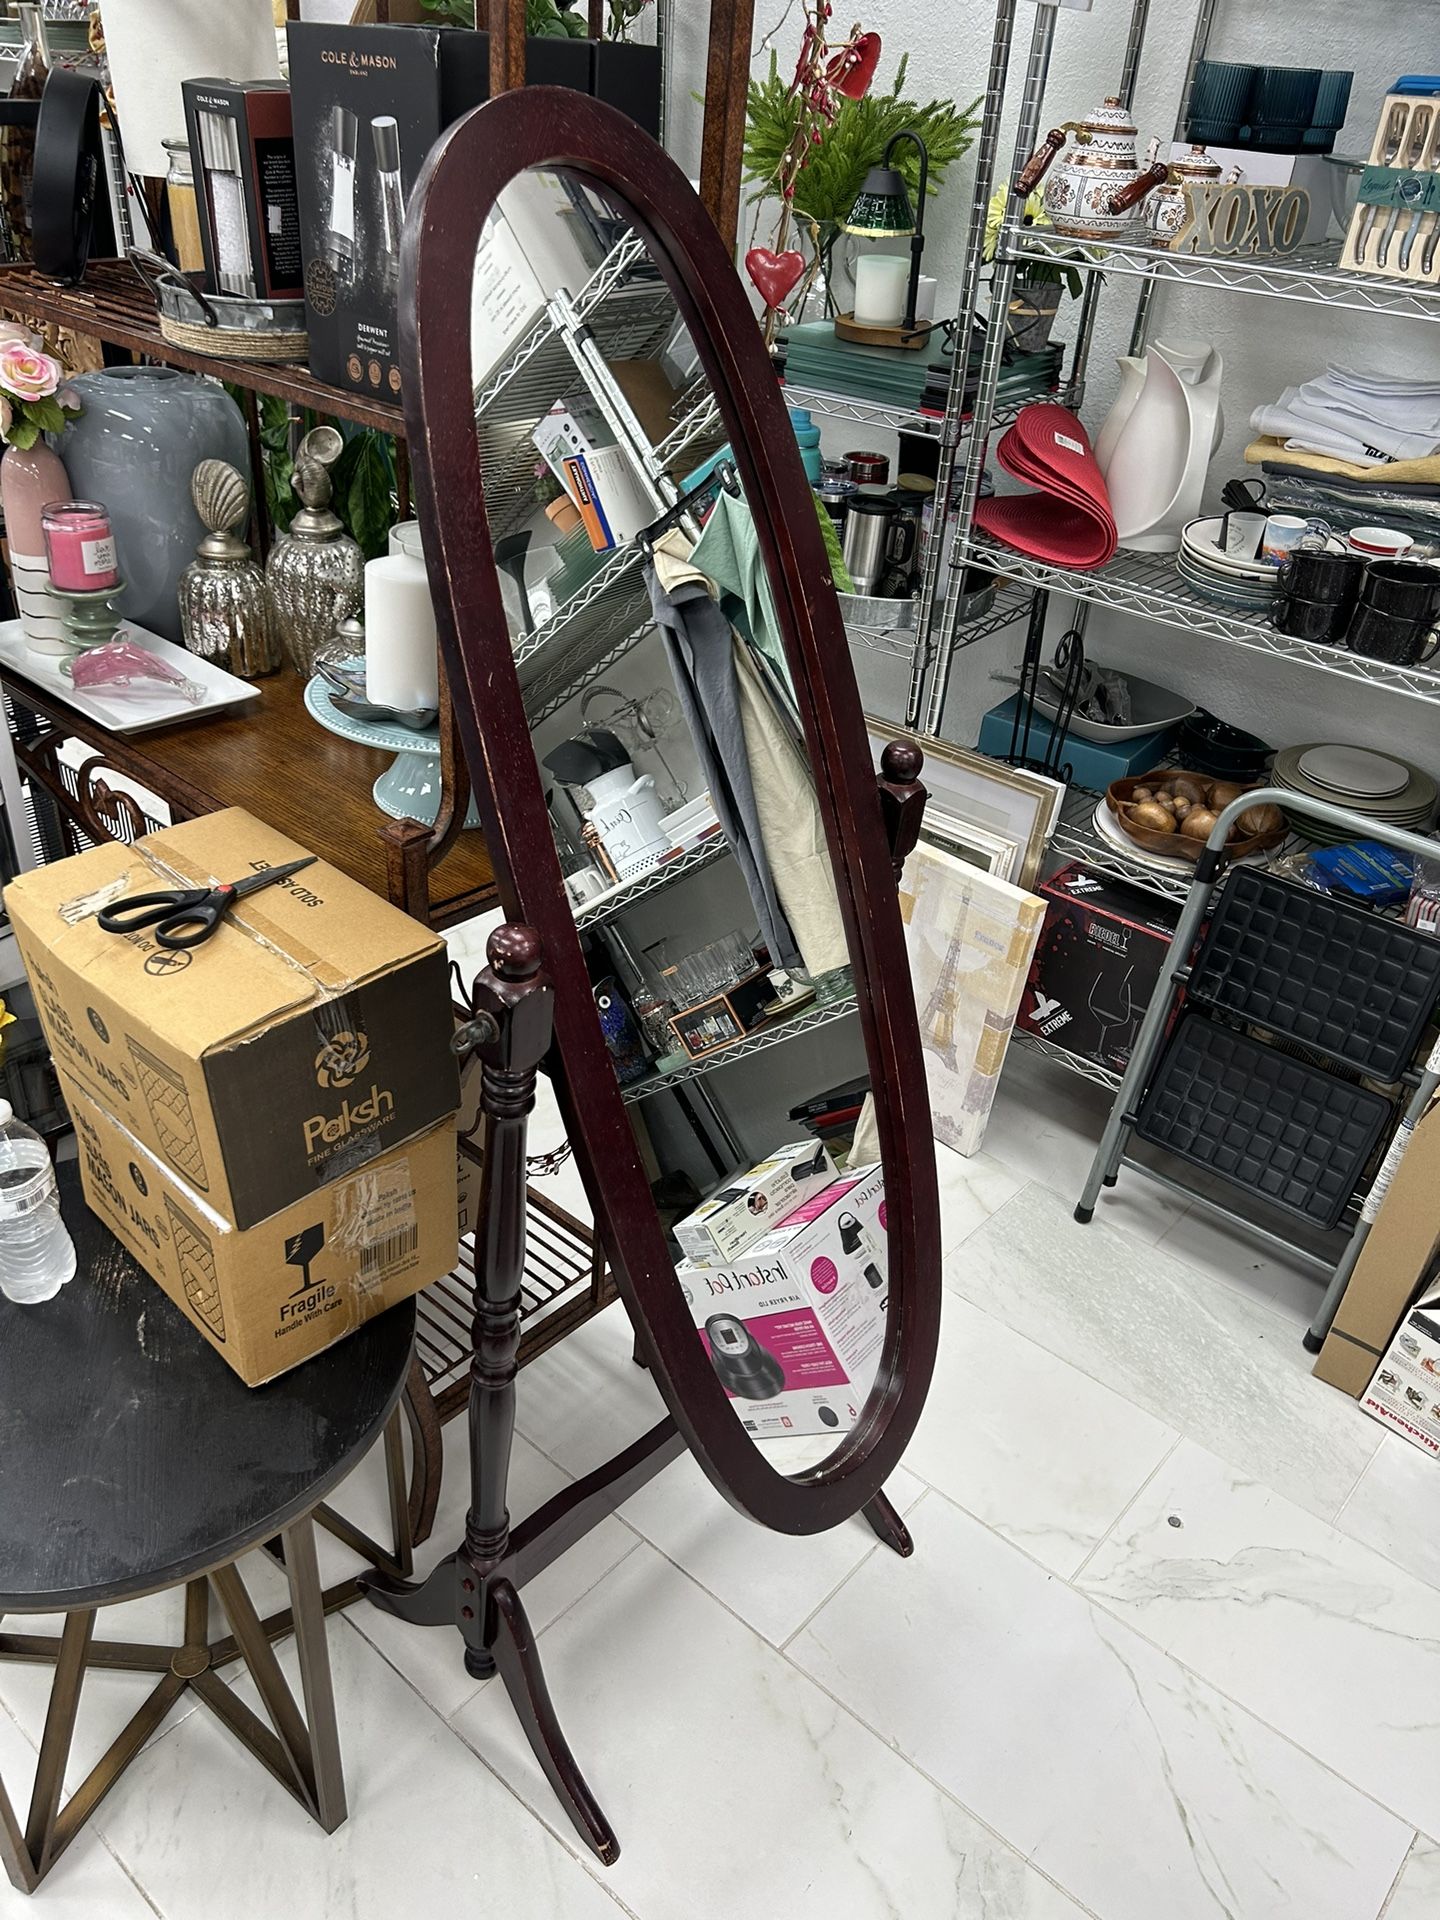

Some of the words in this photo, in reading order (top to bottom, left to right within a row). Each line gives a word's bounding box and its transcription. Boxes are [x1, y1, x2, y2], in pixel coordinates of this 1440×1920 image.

[321, 50, 347, 64] COLE
[350, 51, 360, 67] &
[360, 54, 397, 69] MASON
[196, 94, 208, 103] COLE
[213, 97, 230, 106] MASON
[1178, 186, 1311, 254] XOXO
[357, 322, 389, 338] DERWENT
[249, 859, 275, 873] ET
[292, 885, 324, 908] SOLD
[1071, 886, 1104, 895] EXTREME
[122, 931, 142, 945] NOT
[140, 938, 157, 952] DO
[1089, 922, 1121, 946] RIEDEL
[1040, 1010, 1073, 1037] EXTREME
[93, 1054, 130, 1102] JARS
[303, 1084, 394, 1155] Paksh
[307, 1147, 332, 1167] FINE
[333, 1111, 397, 1152] GLASSWARE
[129, 1203, 161, 1250] JARS
[280, 1285, 335, 1321] Fragile
[274, 1318, 303, 1339] Handle
[304, 1308, 323, 1323] With
[324, 1298, 343, 1312] Care
[1365, 1397, 1440, 1453] KitchenAid
